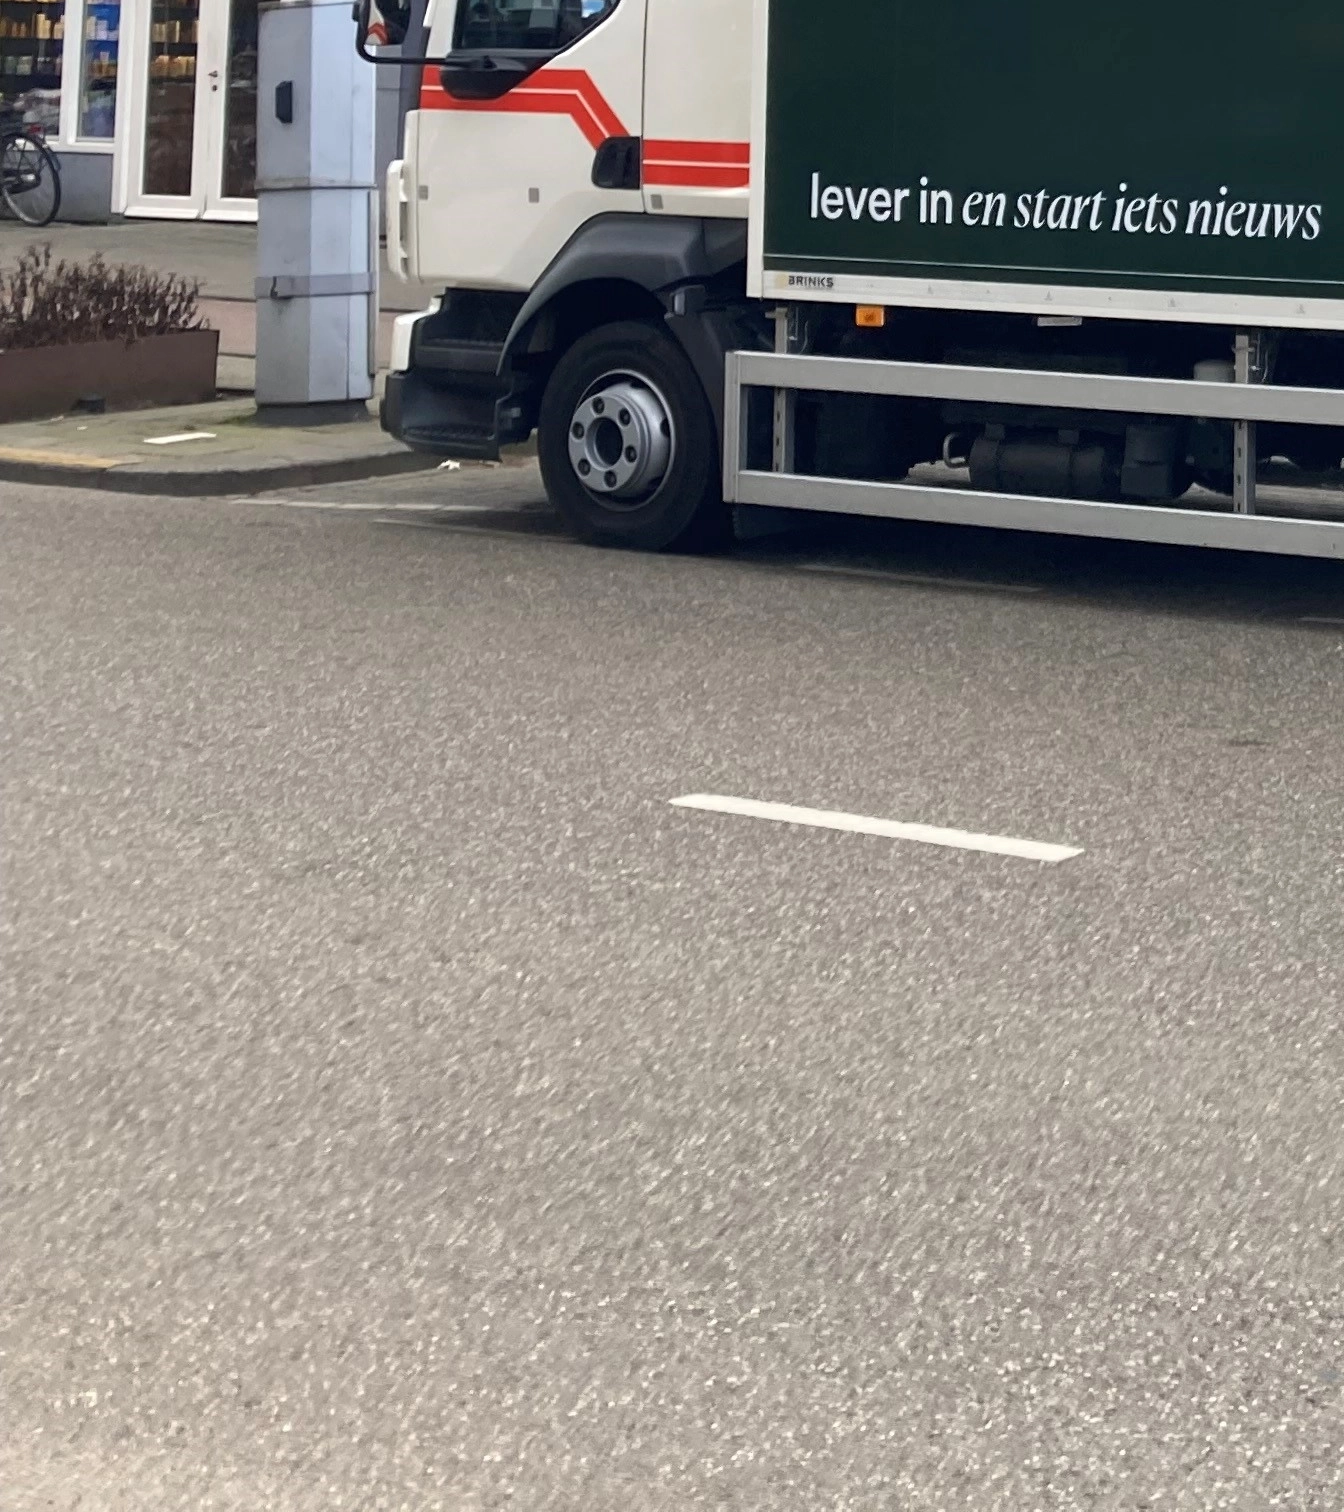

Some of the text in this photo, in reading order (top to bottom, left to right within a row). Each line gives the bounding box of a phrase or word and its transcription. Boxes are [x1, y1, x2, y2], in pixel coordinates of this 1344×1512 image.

[810, 172, 1322, 240] lever in en start iets nieuws
[788, 275, 834, 288] BRINKS
